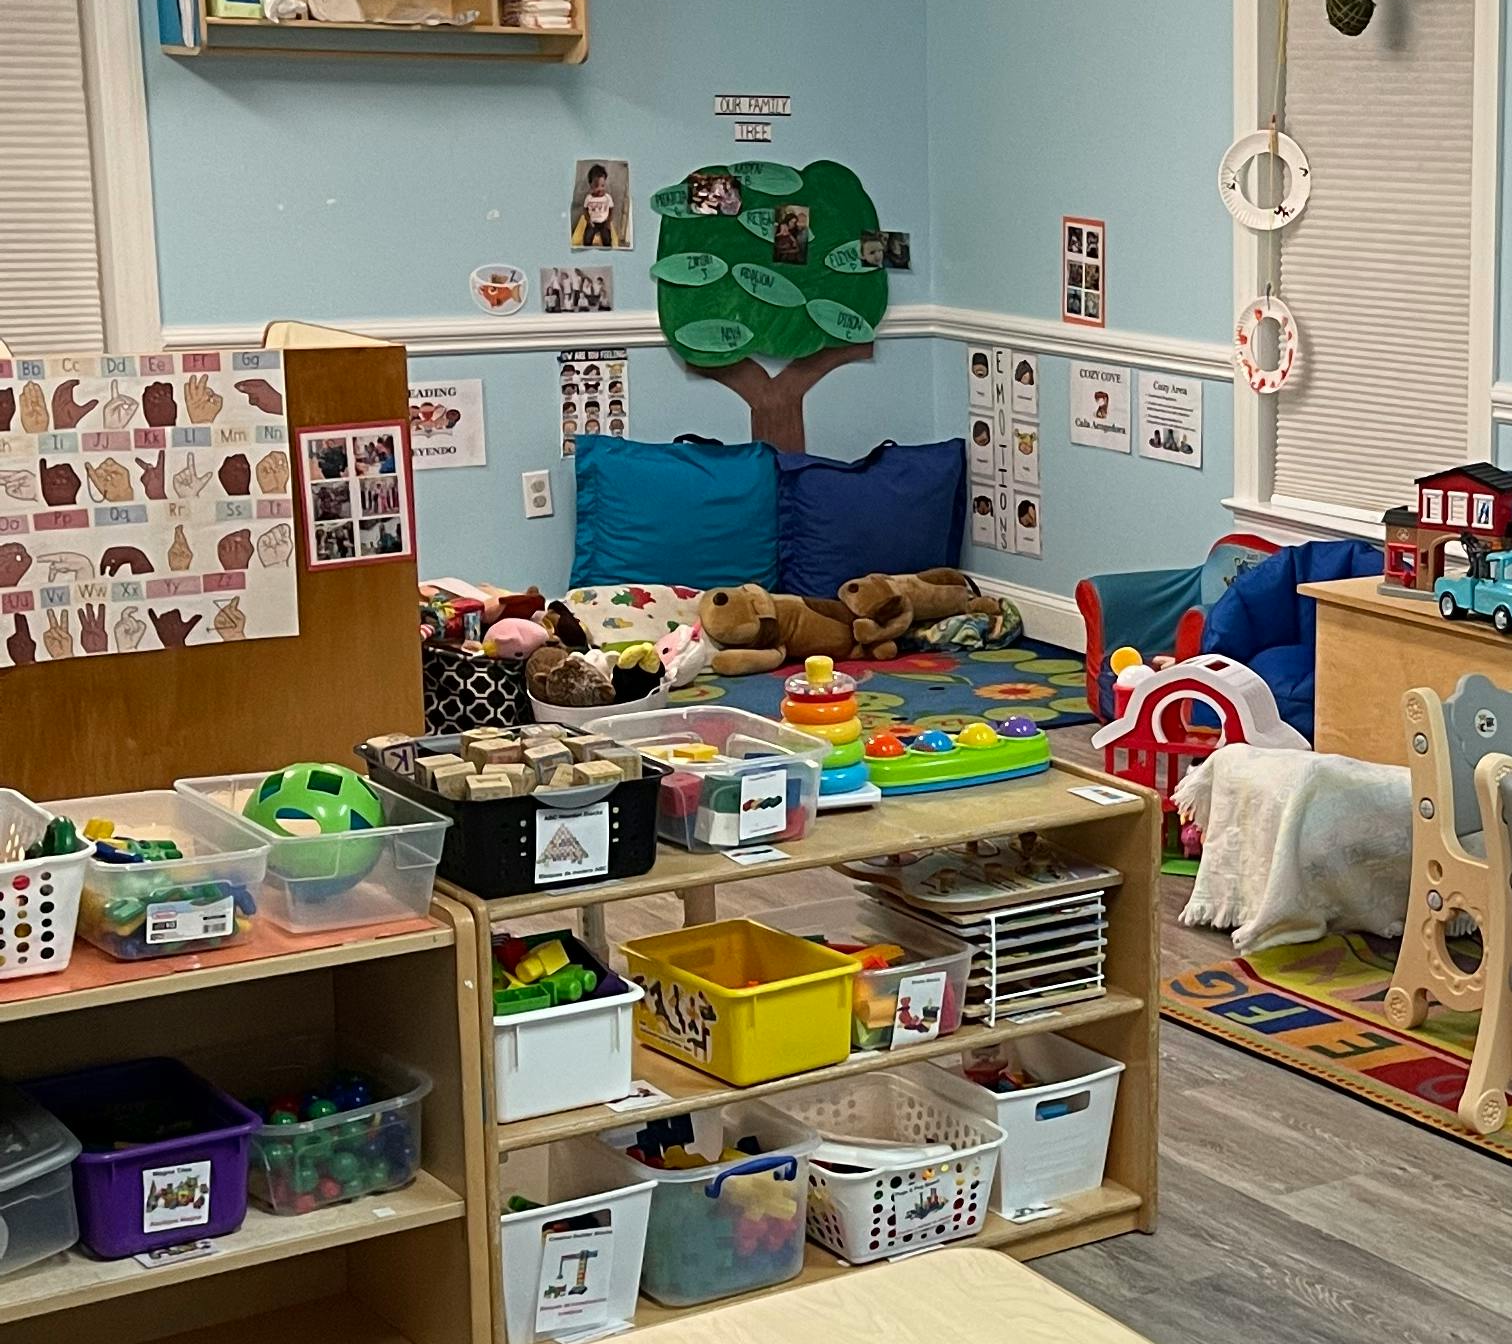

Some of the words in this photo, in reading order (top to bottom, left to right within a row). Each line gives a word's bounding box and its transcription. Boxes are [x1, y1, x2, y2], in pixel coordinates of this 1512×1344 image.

[719, 97, 742, 112] OUR
[747, 97, 789, 114] FAMILY
[738, 124, 769, 140] TREE
[21, 361, 42, 377] Bb
[61, 357, 81, 373] Cc
[106, 356, 127, 374] Dd
[148, 356, 166, 372] Ee
[241, 350, 261, 370] Gg
[408, 386, 457, 399] EADING
[220, 427, 248, 444] Mm
[263, 425, 283, 440] Nn
[411, 445, 457, 457] EYENDO
[53, 510, 73, 529] Pp
[109, 505, 130, 524] Qq
[225, 502, 244, 518] Ss
[46, 588, 65, 605] Vv
[76, 583, 109, 599] Ww
[119, 581, 140, 599] Xx
[162, 580, 181, 598] Yy
